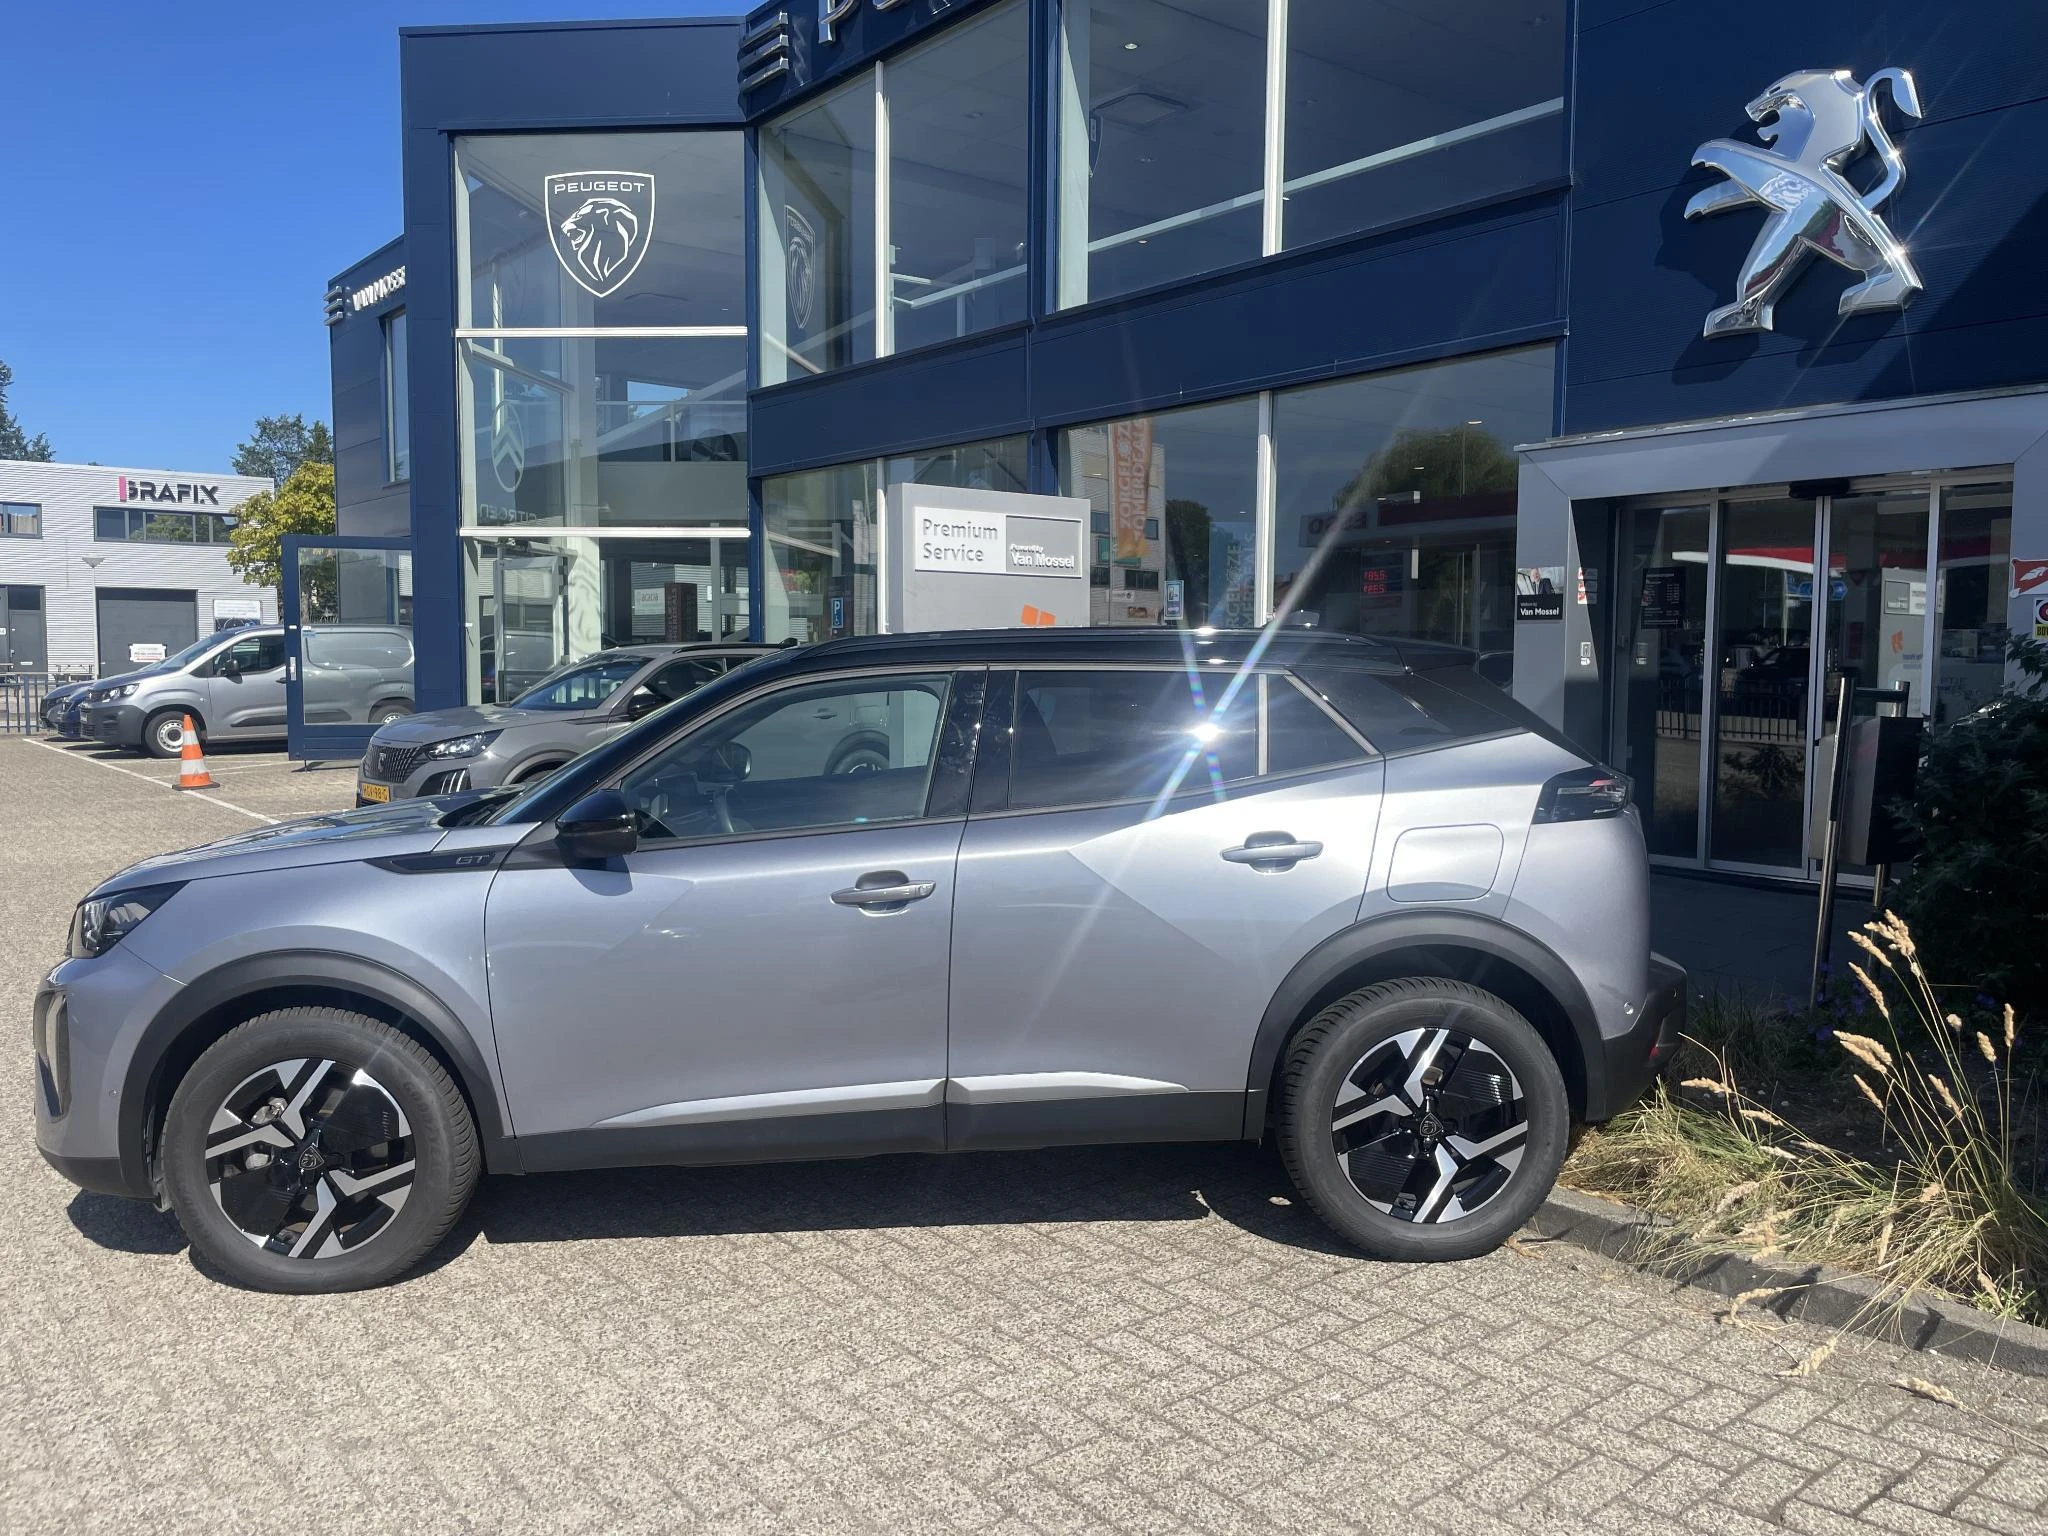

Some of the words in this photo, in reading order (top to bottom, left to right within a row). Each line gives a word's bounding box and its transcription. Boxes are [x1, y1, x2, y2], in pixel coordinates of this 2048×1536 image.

[554, 181, 645, 194] PEUGEOT
[922, 518, 998, 540] Premium
[922, 542, 984, 561] Service
[1011, 552, 1033, 566] Van
[1035, 553, 1075, 569] Mossel
[834, 600, 841, 614] P
[1520, 608, 1534, 616] Van
[1534, 607, 1560, 616] Mossel
[2036, 626, 2048, 636] BO
[455, 854, 490, 865] GT
